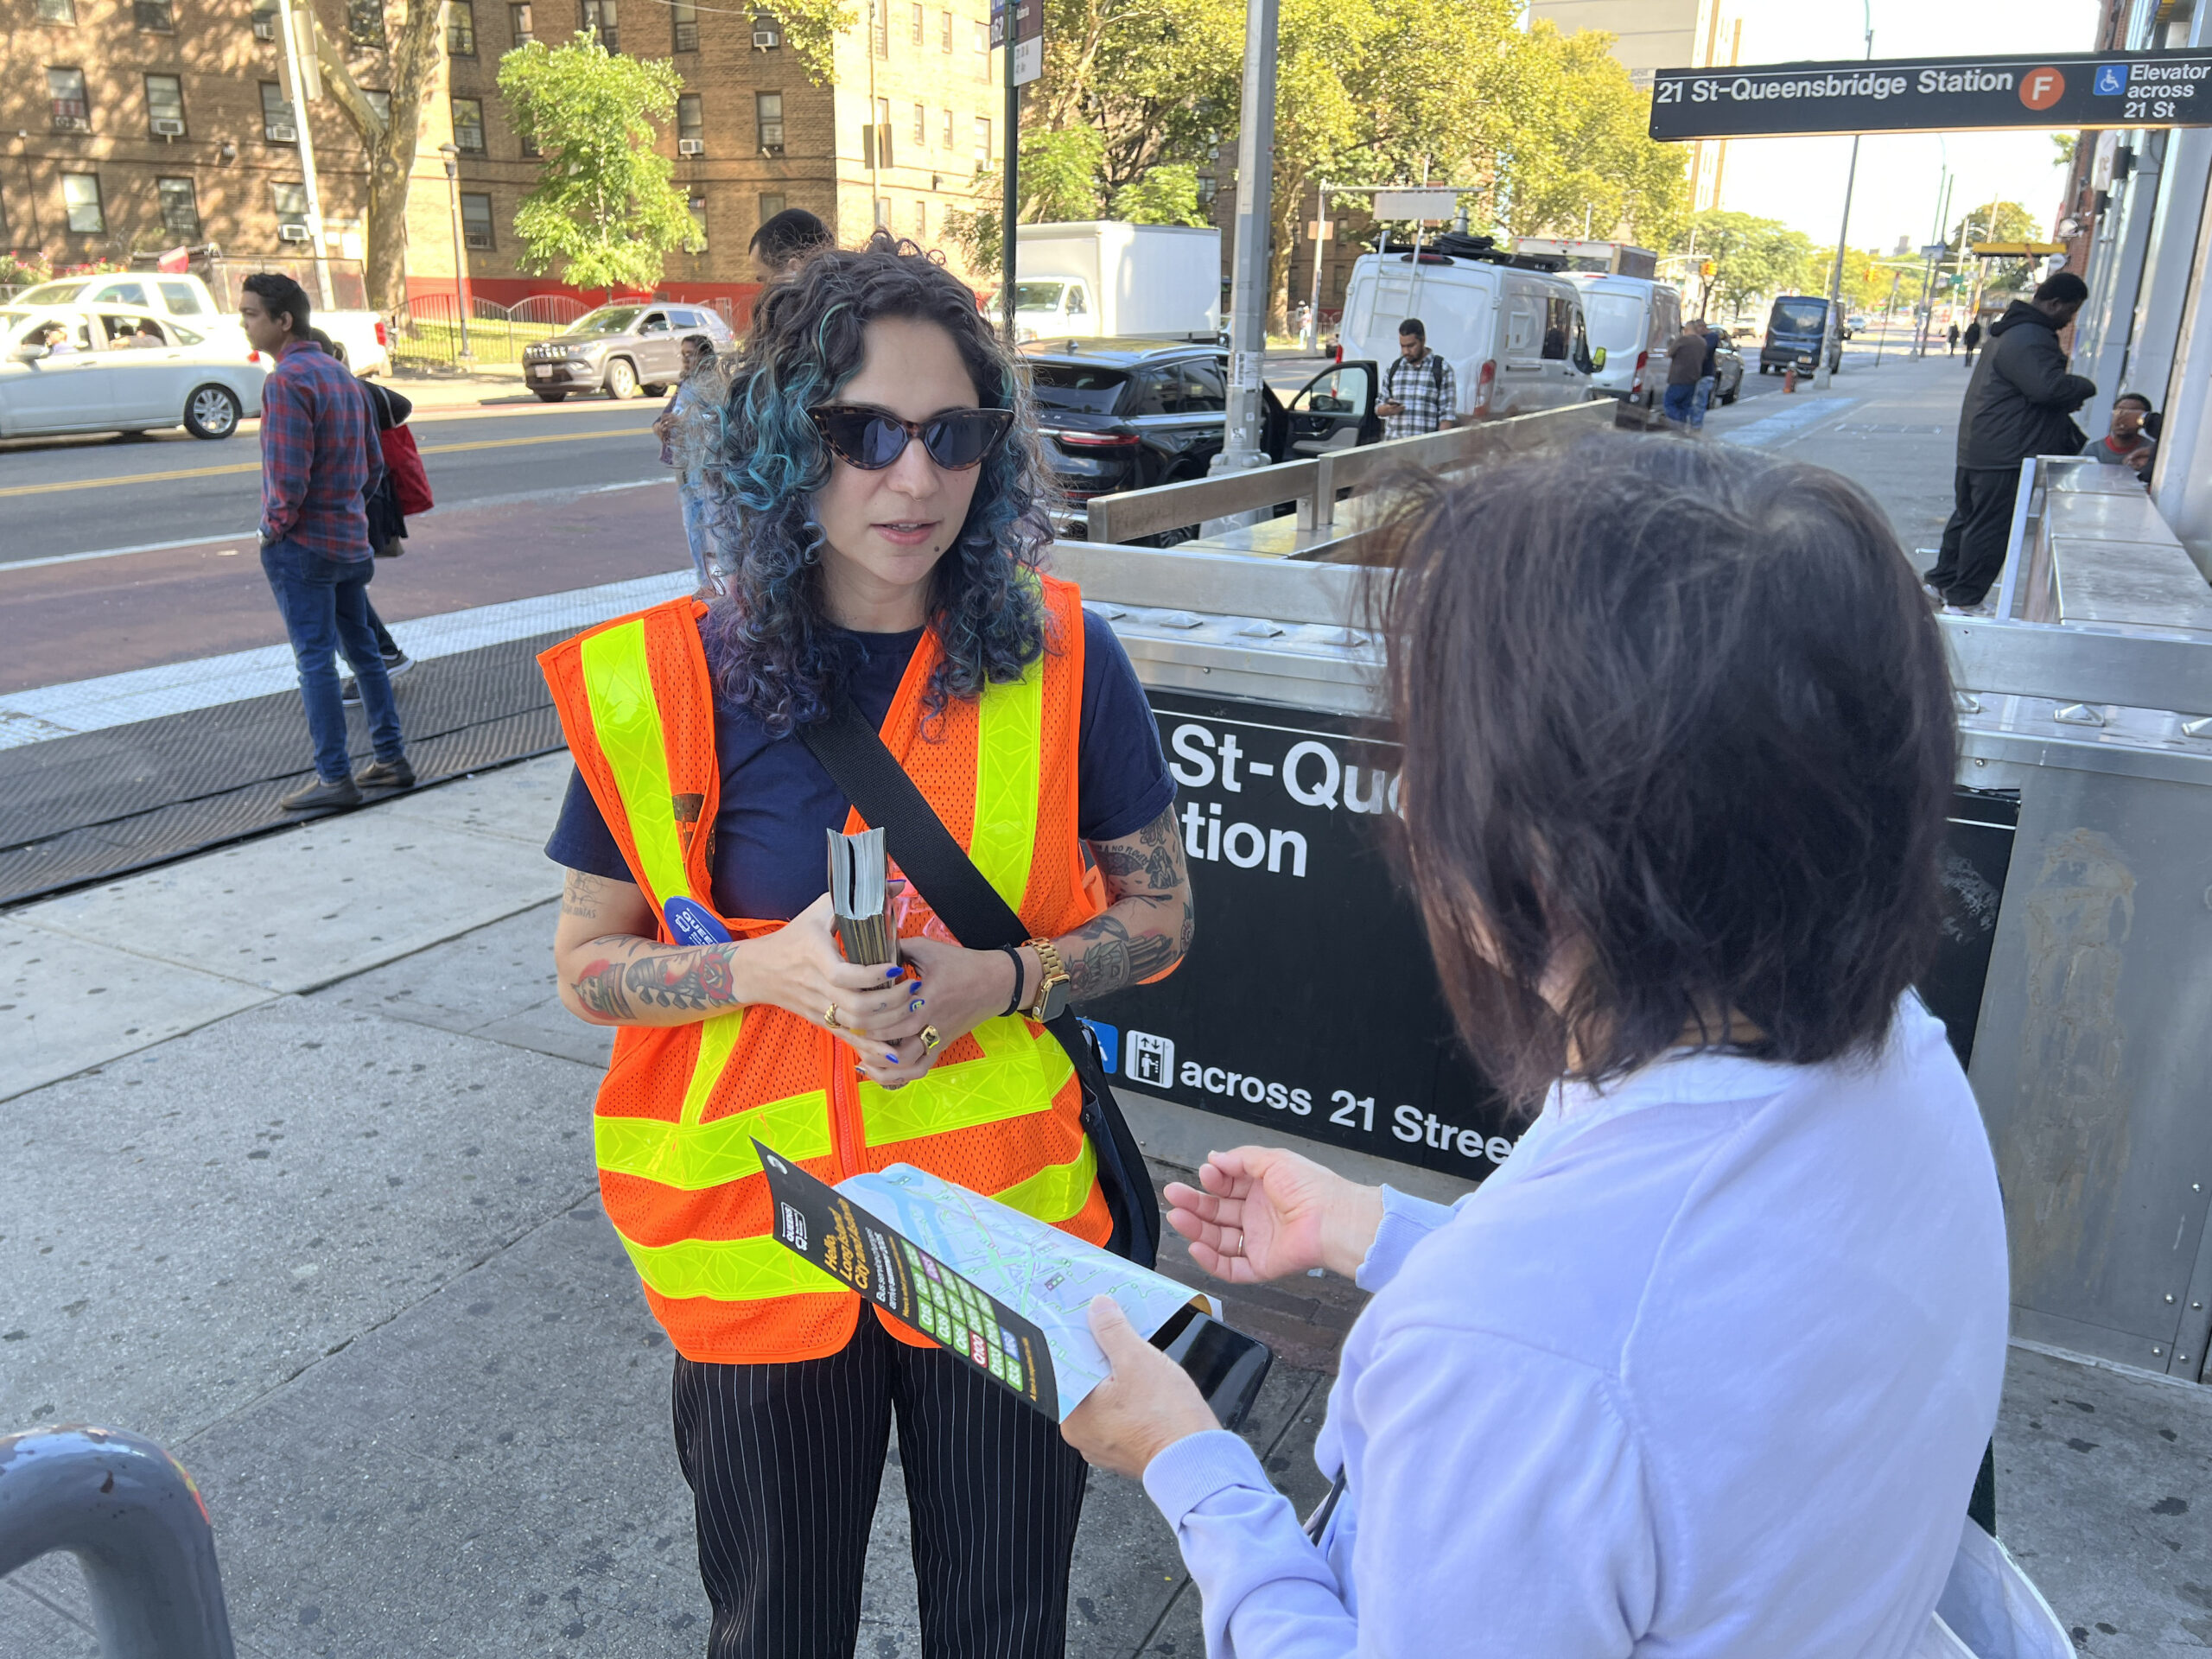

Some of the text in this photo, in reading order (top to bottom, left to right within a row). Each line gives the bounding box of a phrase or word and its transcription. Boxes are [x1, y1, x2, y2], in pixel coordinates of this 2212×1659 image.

[1656, 68, 2054, 104] 21 St-Queensbridge Station F
[2130, 64, 2211, 81] Elevator
[2126, 83, 2195, 99] across
[2123, 101, 2176, 119] 21 St
[1181, 801, 1307, 878] tion
[683, 911, 715, 944] QUEE
[1180, 1061, 1525, 1165] across 21 Stree
[840, 1243, 854, 1281] Long
